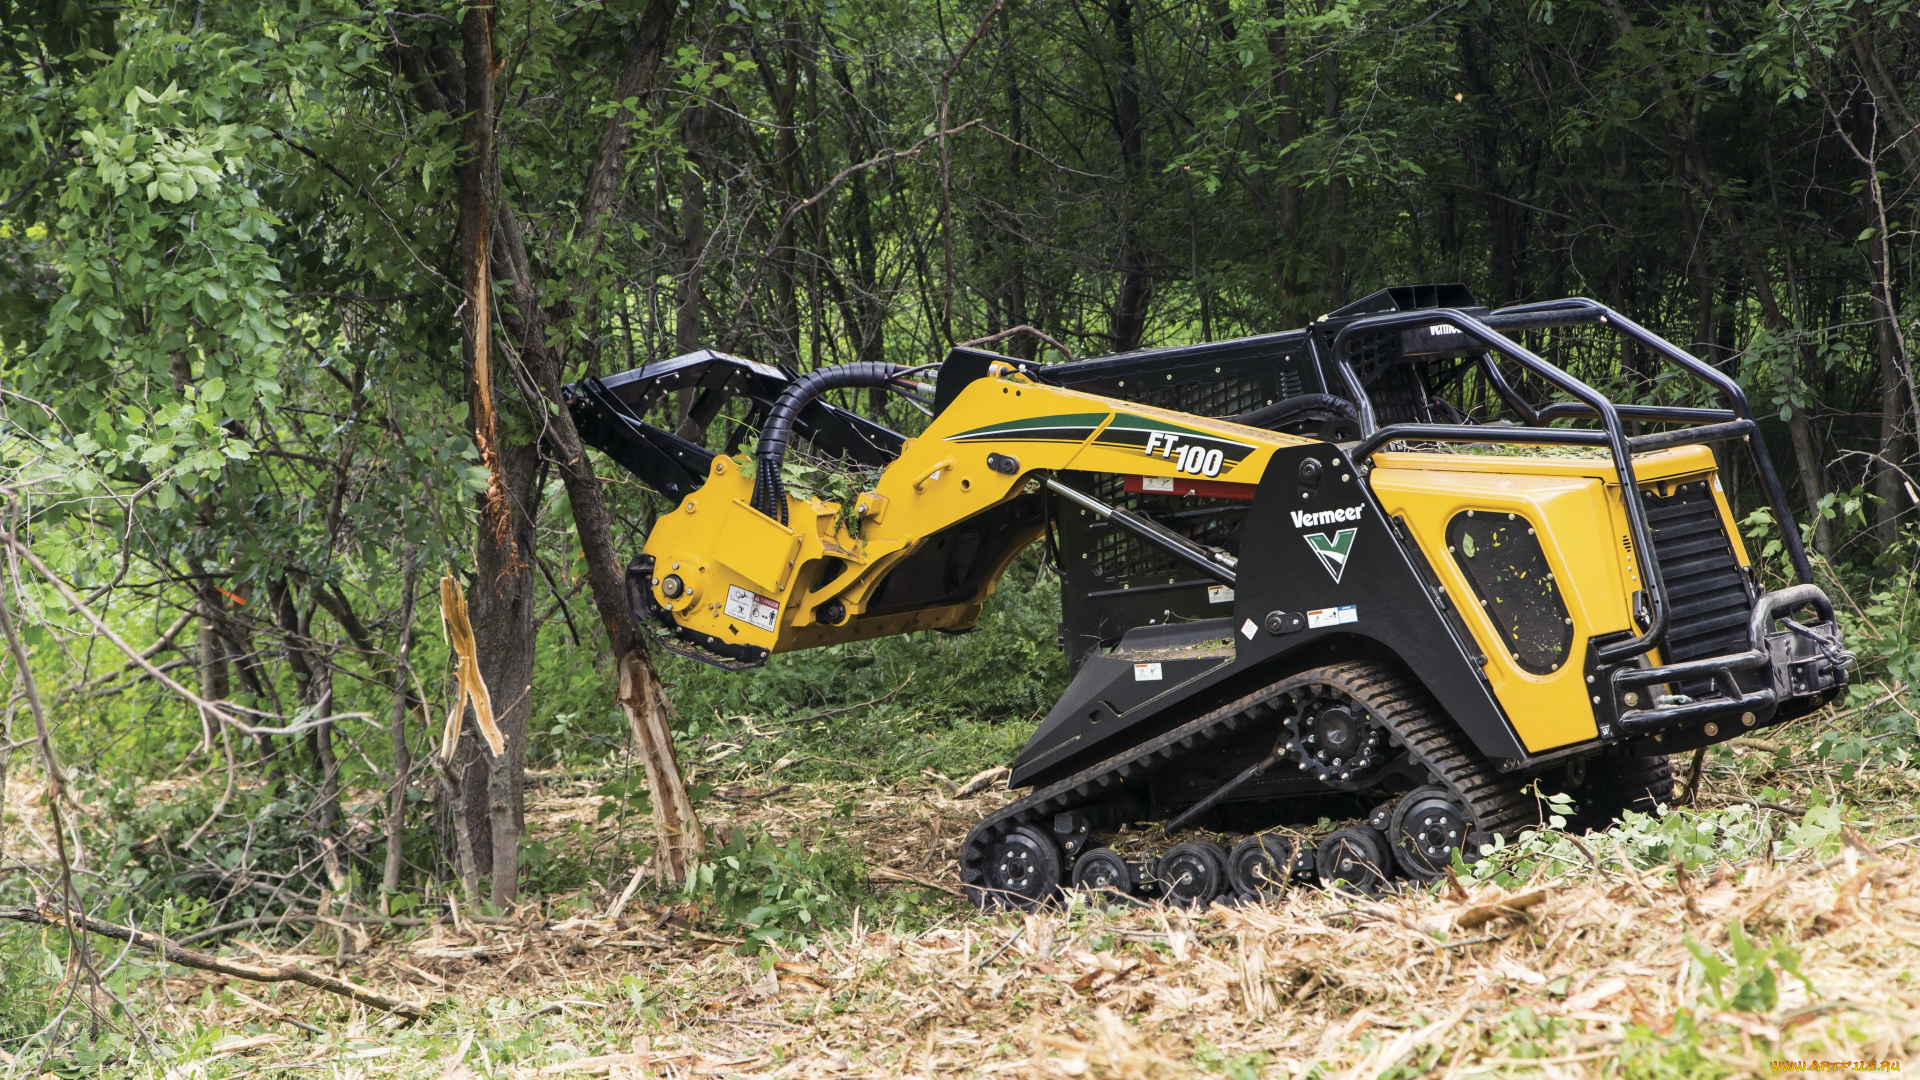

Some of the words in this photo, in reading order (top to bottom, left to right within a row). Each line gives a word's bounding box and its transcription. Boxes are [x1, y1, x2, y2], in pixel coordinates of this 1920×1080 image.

[1145, 432, 1179, 459] FT
[1176, 444, 1224, 477] 100
[1290, 505, 1363, 528] Vermeer
